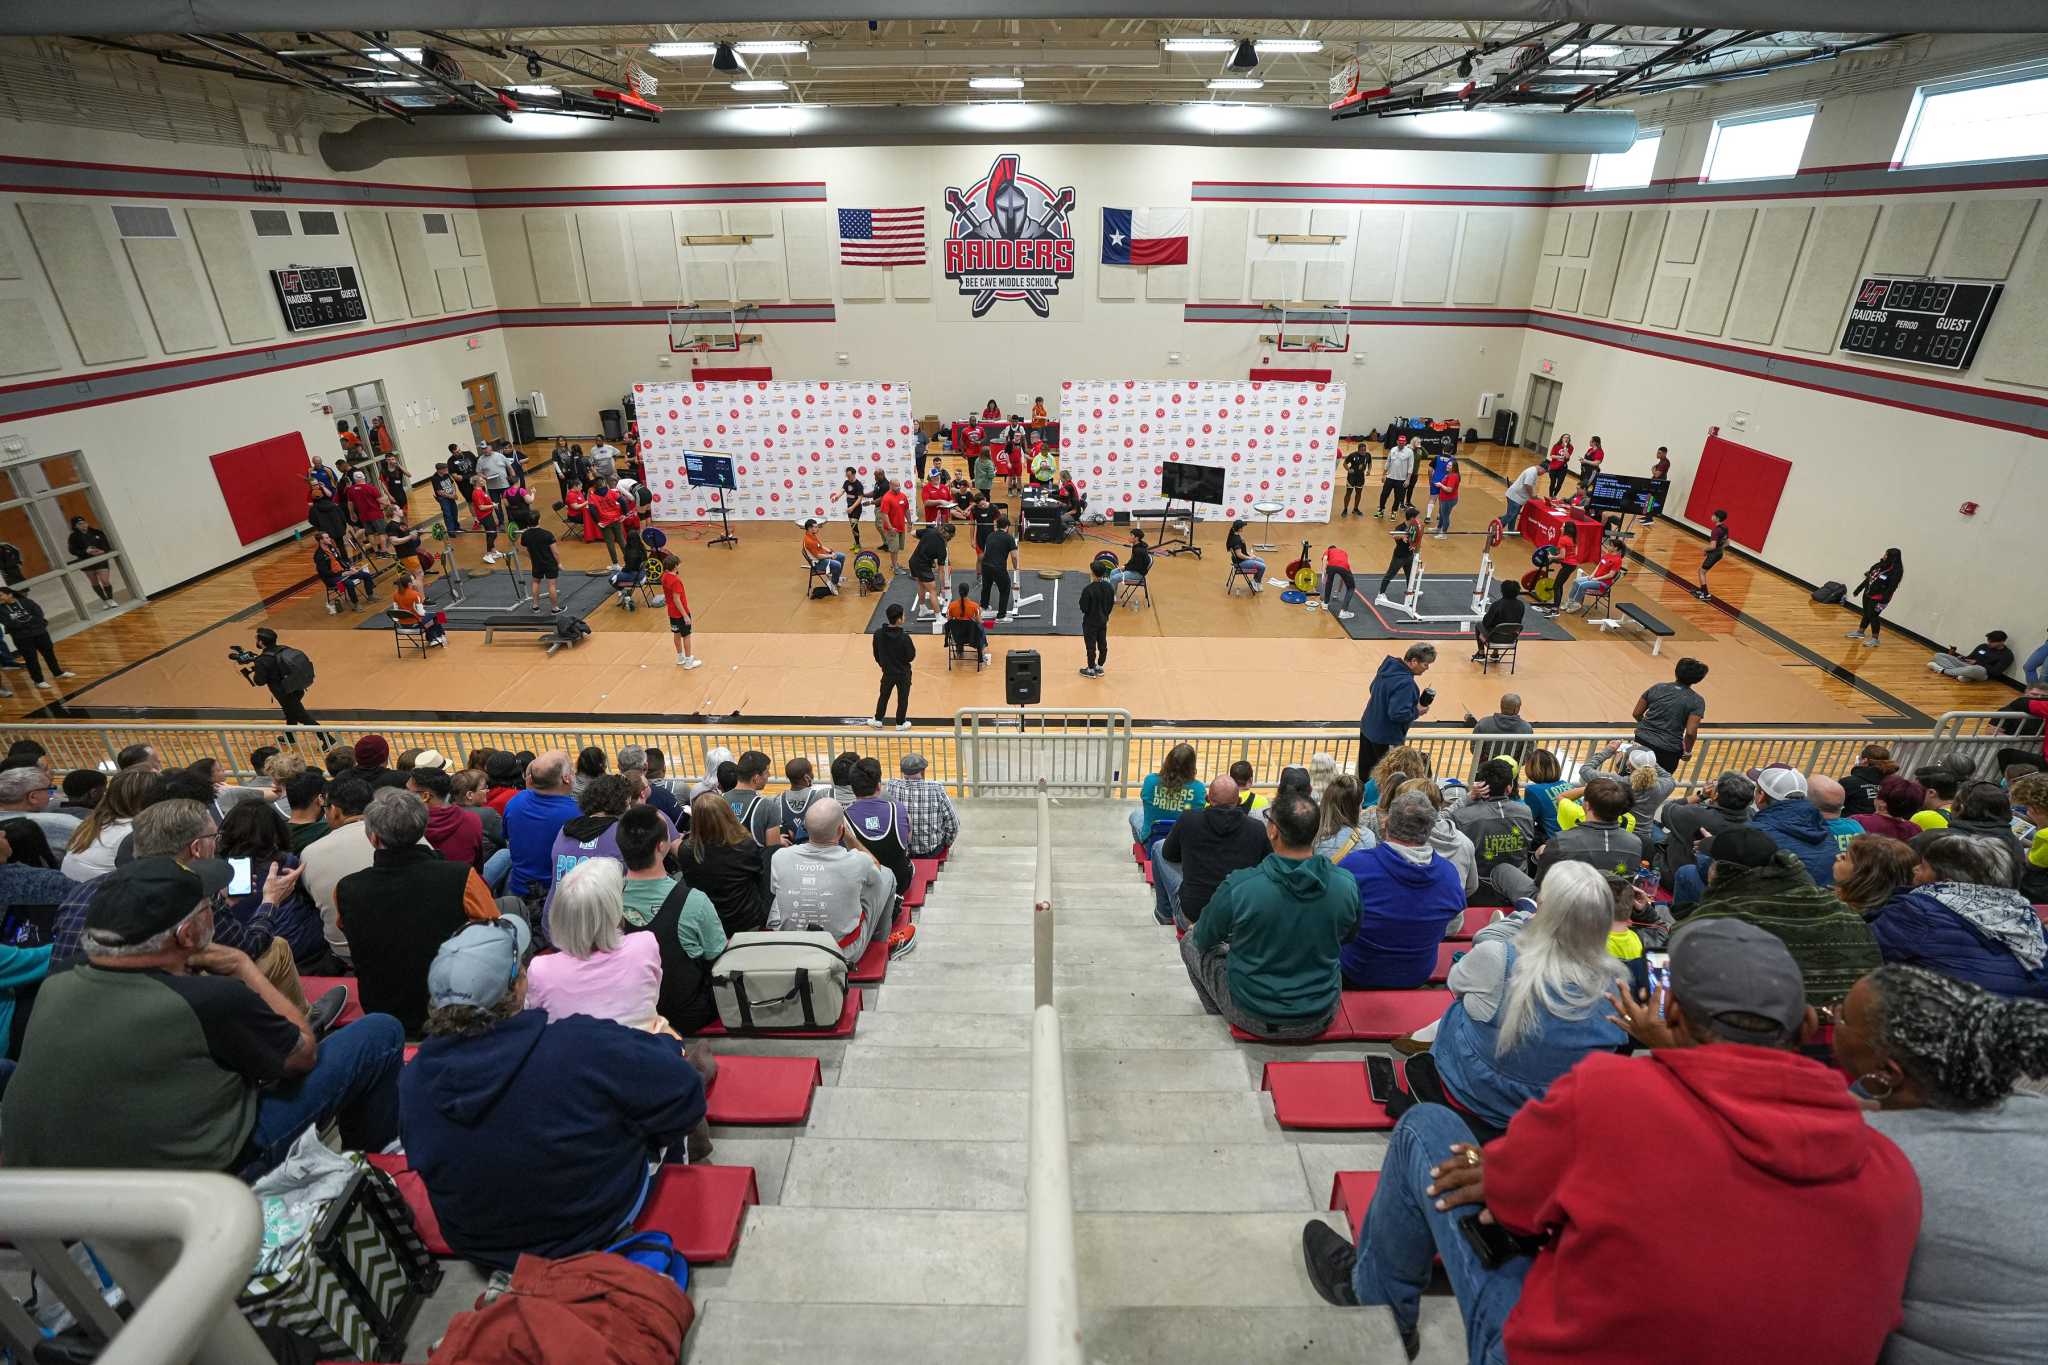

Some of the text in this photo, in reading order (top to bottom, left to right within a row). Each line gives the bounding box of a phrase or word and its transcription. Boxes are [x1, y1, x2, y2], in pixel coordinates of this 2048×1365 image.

[946, 239, 1073, 273] RAIDERS
[965, 277, 1053, 288] BEE CAVE MIDDLE SCHOOL
[286, 294, 312, 304] RAIDERS
[340, 289, 358, 299] GUEST
[1858, 281, 1888, 307] LT
[1851, 309, 1888, 323] RAIDERS
[1895, 320, 1919, 330] PERIOD
[1936, 318, 1971, 332] GUEST
[1152, 797, 1185, 812] PRIDE
[1485, 835, 1524, 852] LAZERS
[795, 863, 825, 872] TOYOTA
